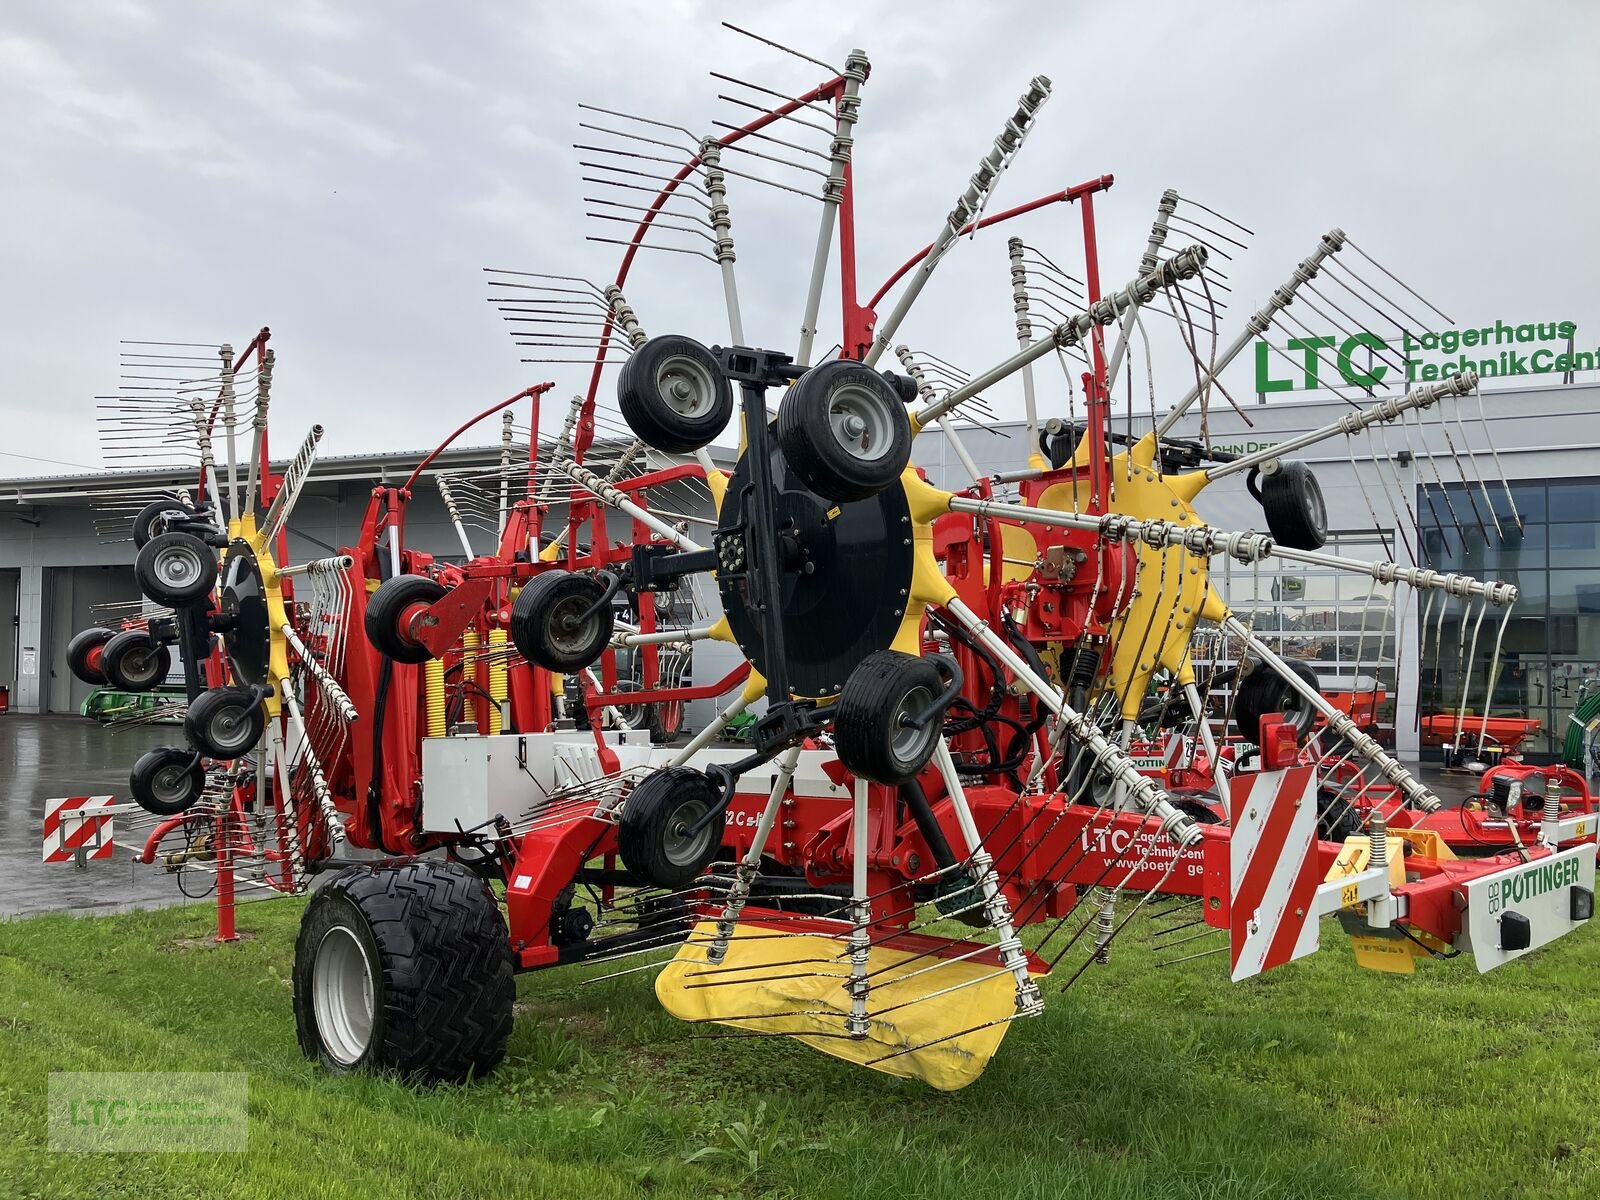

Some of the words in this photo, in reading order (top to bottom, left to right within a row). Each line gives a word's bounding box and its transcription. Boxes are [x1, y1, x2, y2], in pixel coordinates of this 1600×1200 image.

[1402, 319, 1577, 354] Lagerhaus
[1255, 332, 1388, 393] LTC
[622, 609, 629, 620] 4
[1081, 828, 1130, 854] LTC
